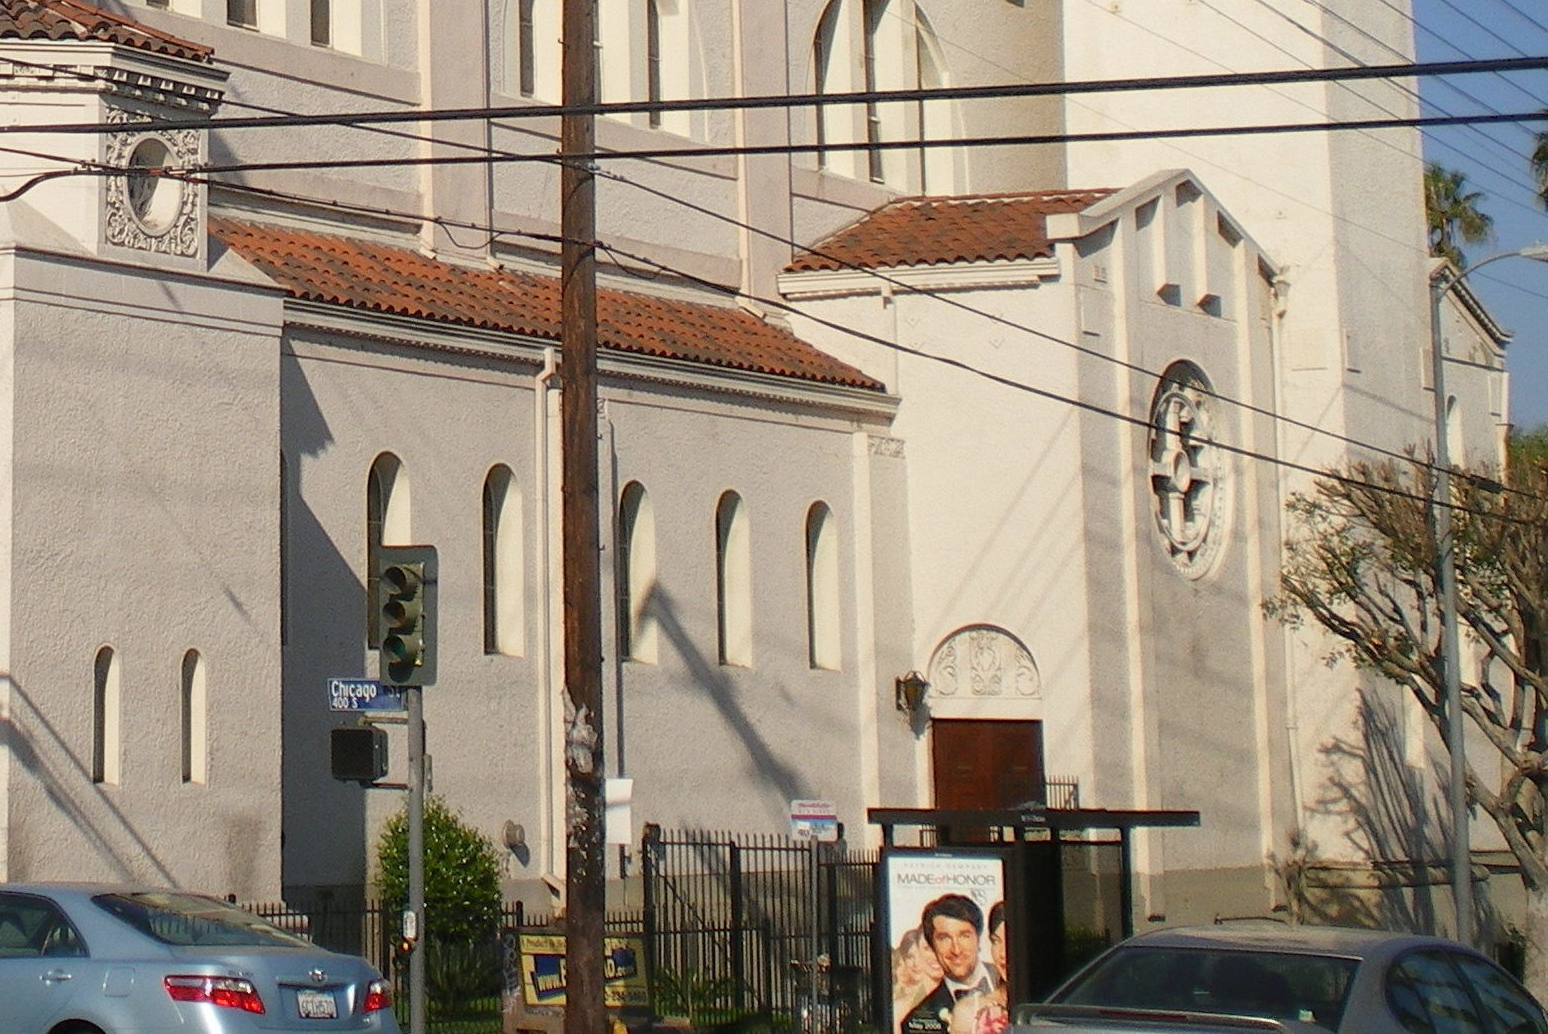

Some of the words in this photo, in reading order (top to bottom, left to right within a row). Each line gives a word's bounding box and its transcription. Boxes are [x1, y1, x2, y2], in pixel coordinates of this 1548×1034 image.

[331, 680, 377, 703] Chicago
[332, 697, 349, 709] 400
[351, 697, 359, 709] S
